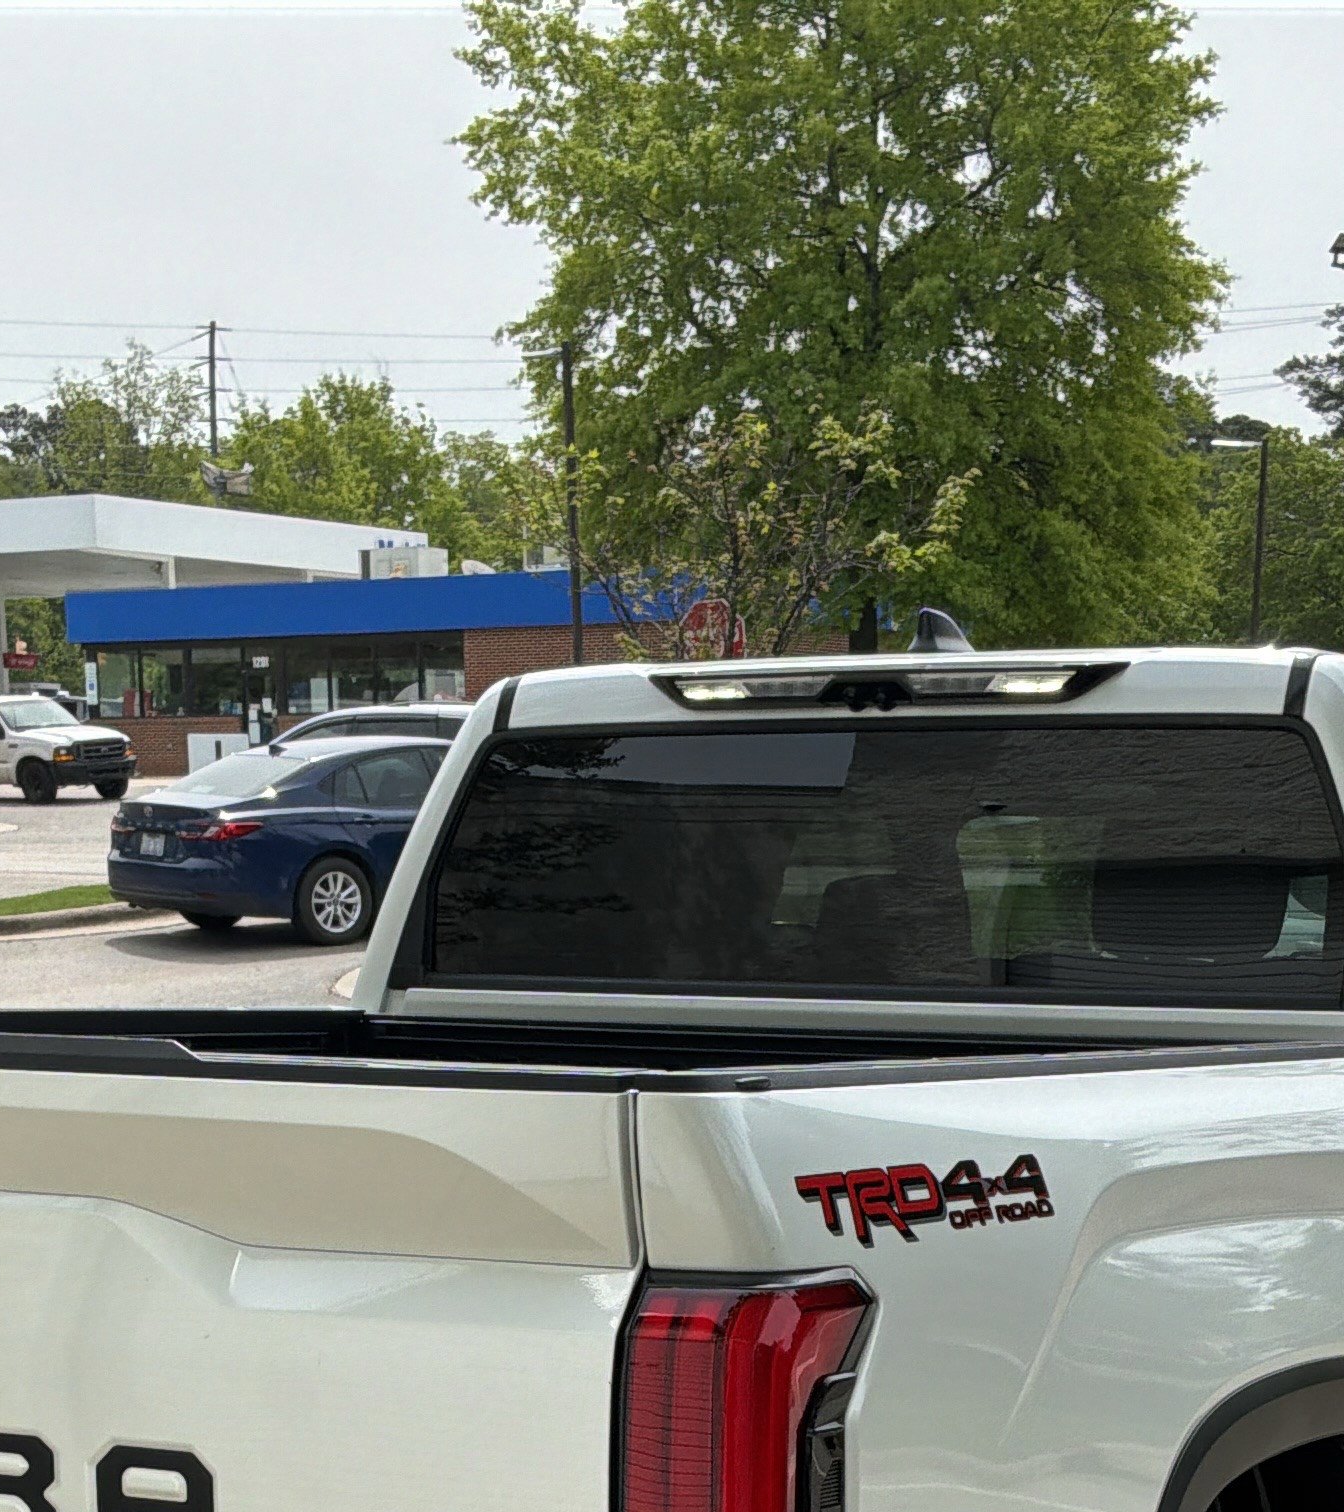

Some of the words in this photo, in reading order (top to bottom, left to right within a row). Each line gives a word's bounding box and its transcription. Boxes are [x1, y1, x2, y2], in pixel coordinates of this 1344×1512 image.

[794, 1163, 947, 1249] TRD
[941, 1153, 1050, 1207] 4x4
[948, 1206, 994, 1230] OFF
[995, 1198, 1056, 1224] ROAD
